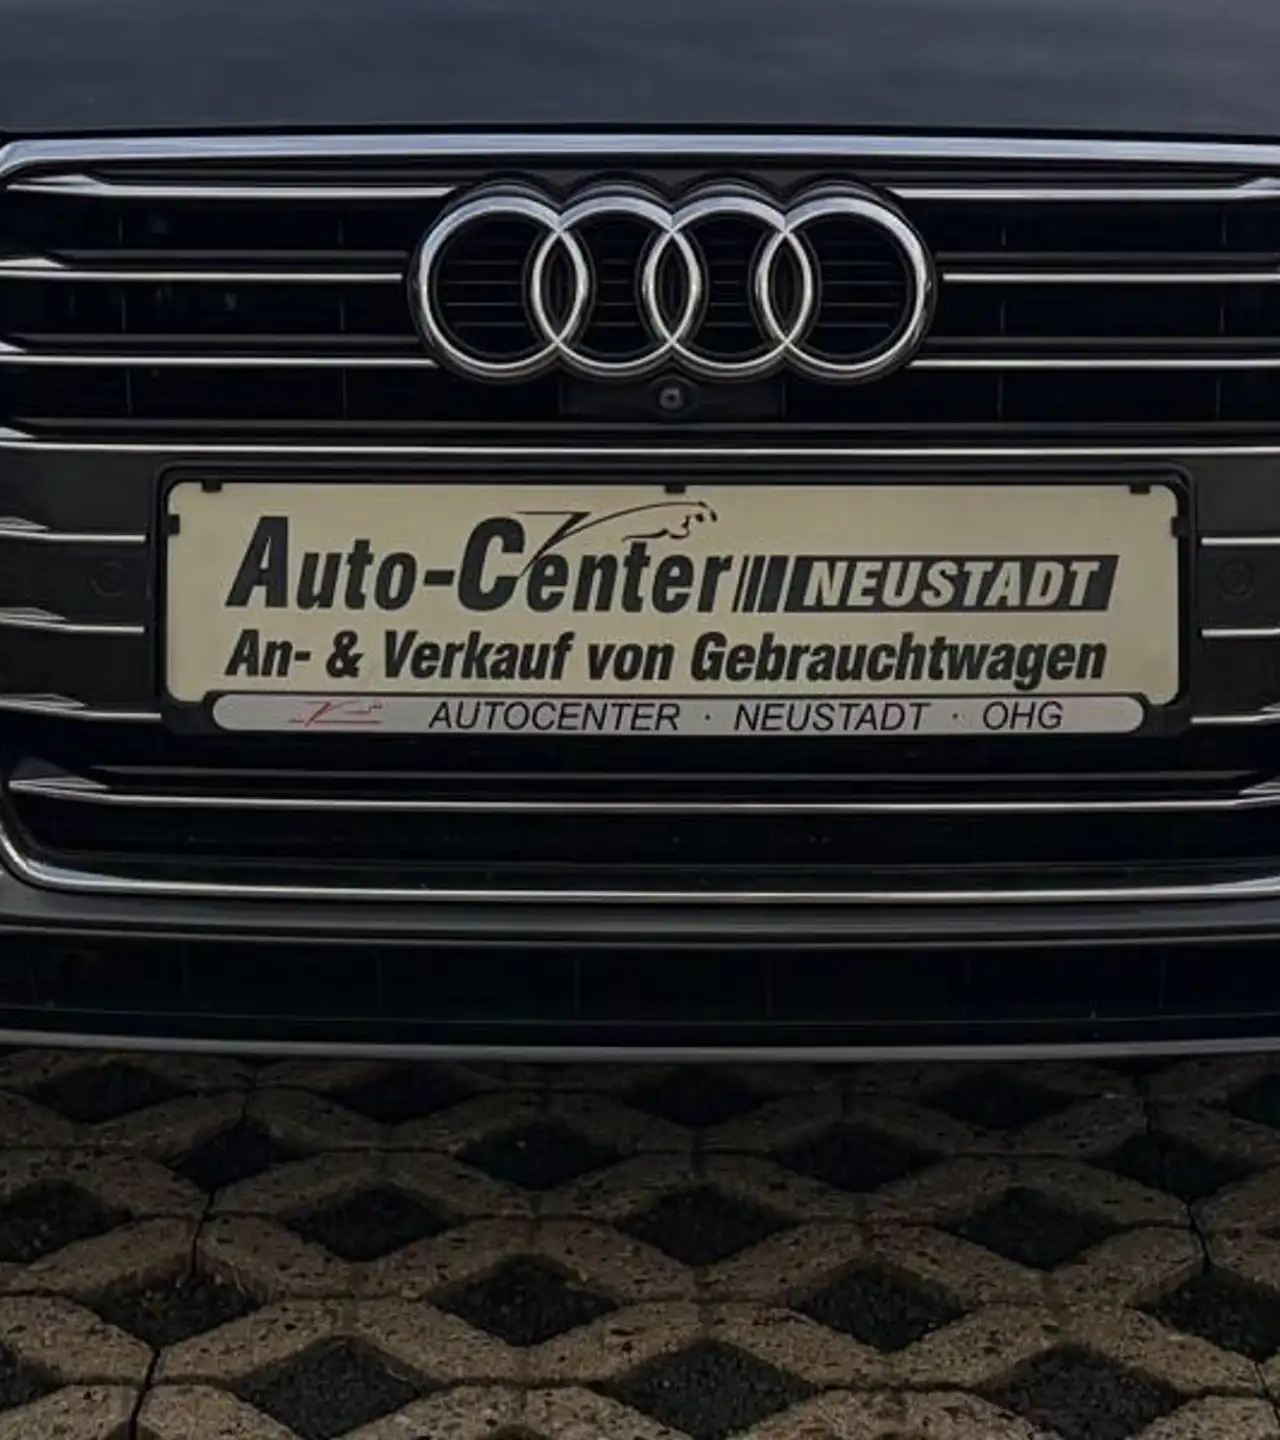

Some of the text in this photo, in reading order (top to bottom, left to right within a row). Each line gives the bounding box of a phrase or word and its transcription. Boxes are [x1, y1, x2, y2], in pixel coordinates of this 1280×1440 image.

[225, 515, 1102, 613] Auto-Center NEUSTADT
[225, 628, 1108, 691] An- & Verkauf von Gebrauchtwagen
[428, 700, 1064, 731] AUTOCENTER NEUSTADT OHG
